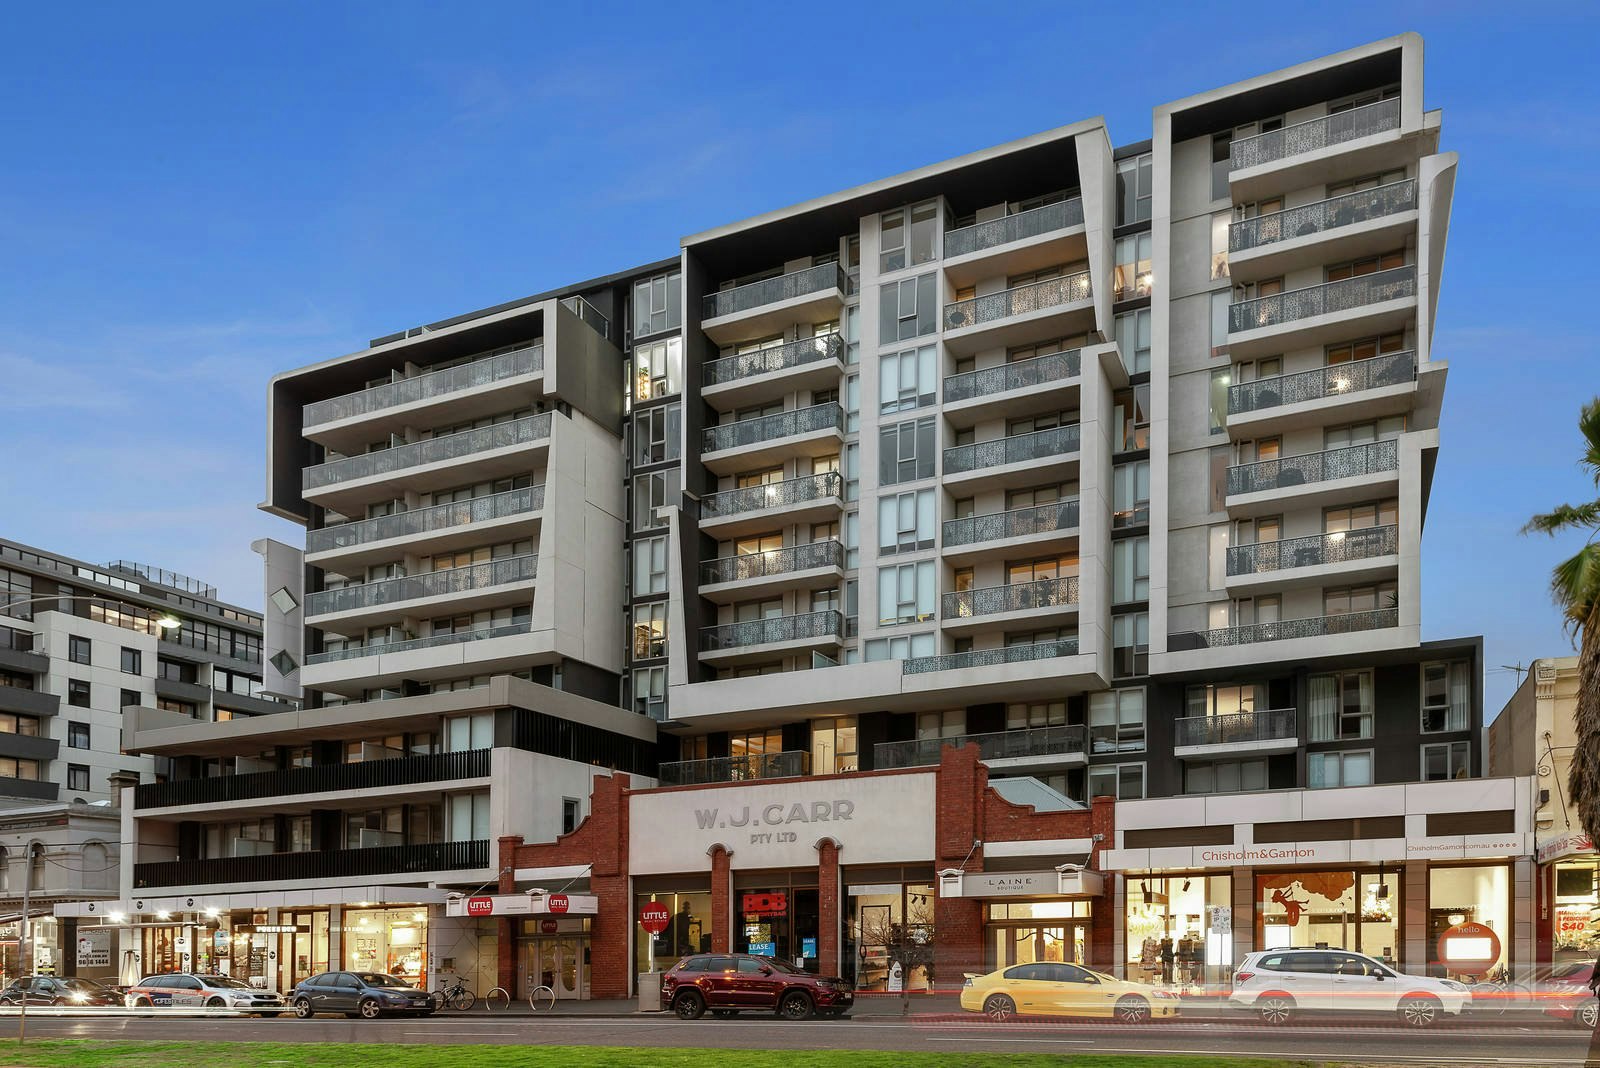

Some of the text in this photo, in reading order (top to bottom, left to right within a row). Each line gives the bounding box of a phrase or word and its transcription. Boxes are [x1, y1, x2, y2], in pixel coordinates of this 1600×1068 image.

[750, 831, 797, 845] PTY LTD
[1201, 848, 1315, 861] Chisholm&Gamon
[988, 878, 1032, 886] LAINE
[469, 901, 491, 909] LITTLE
[642, 911, 668, 920] LITTLE
[1561, 922, 1585, 931] $40
